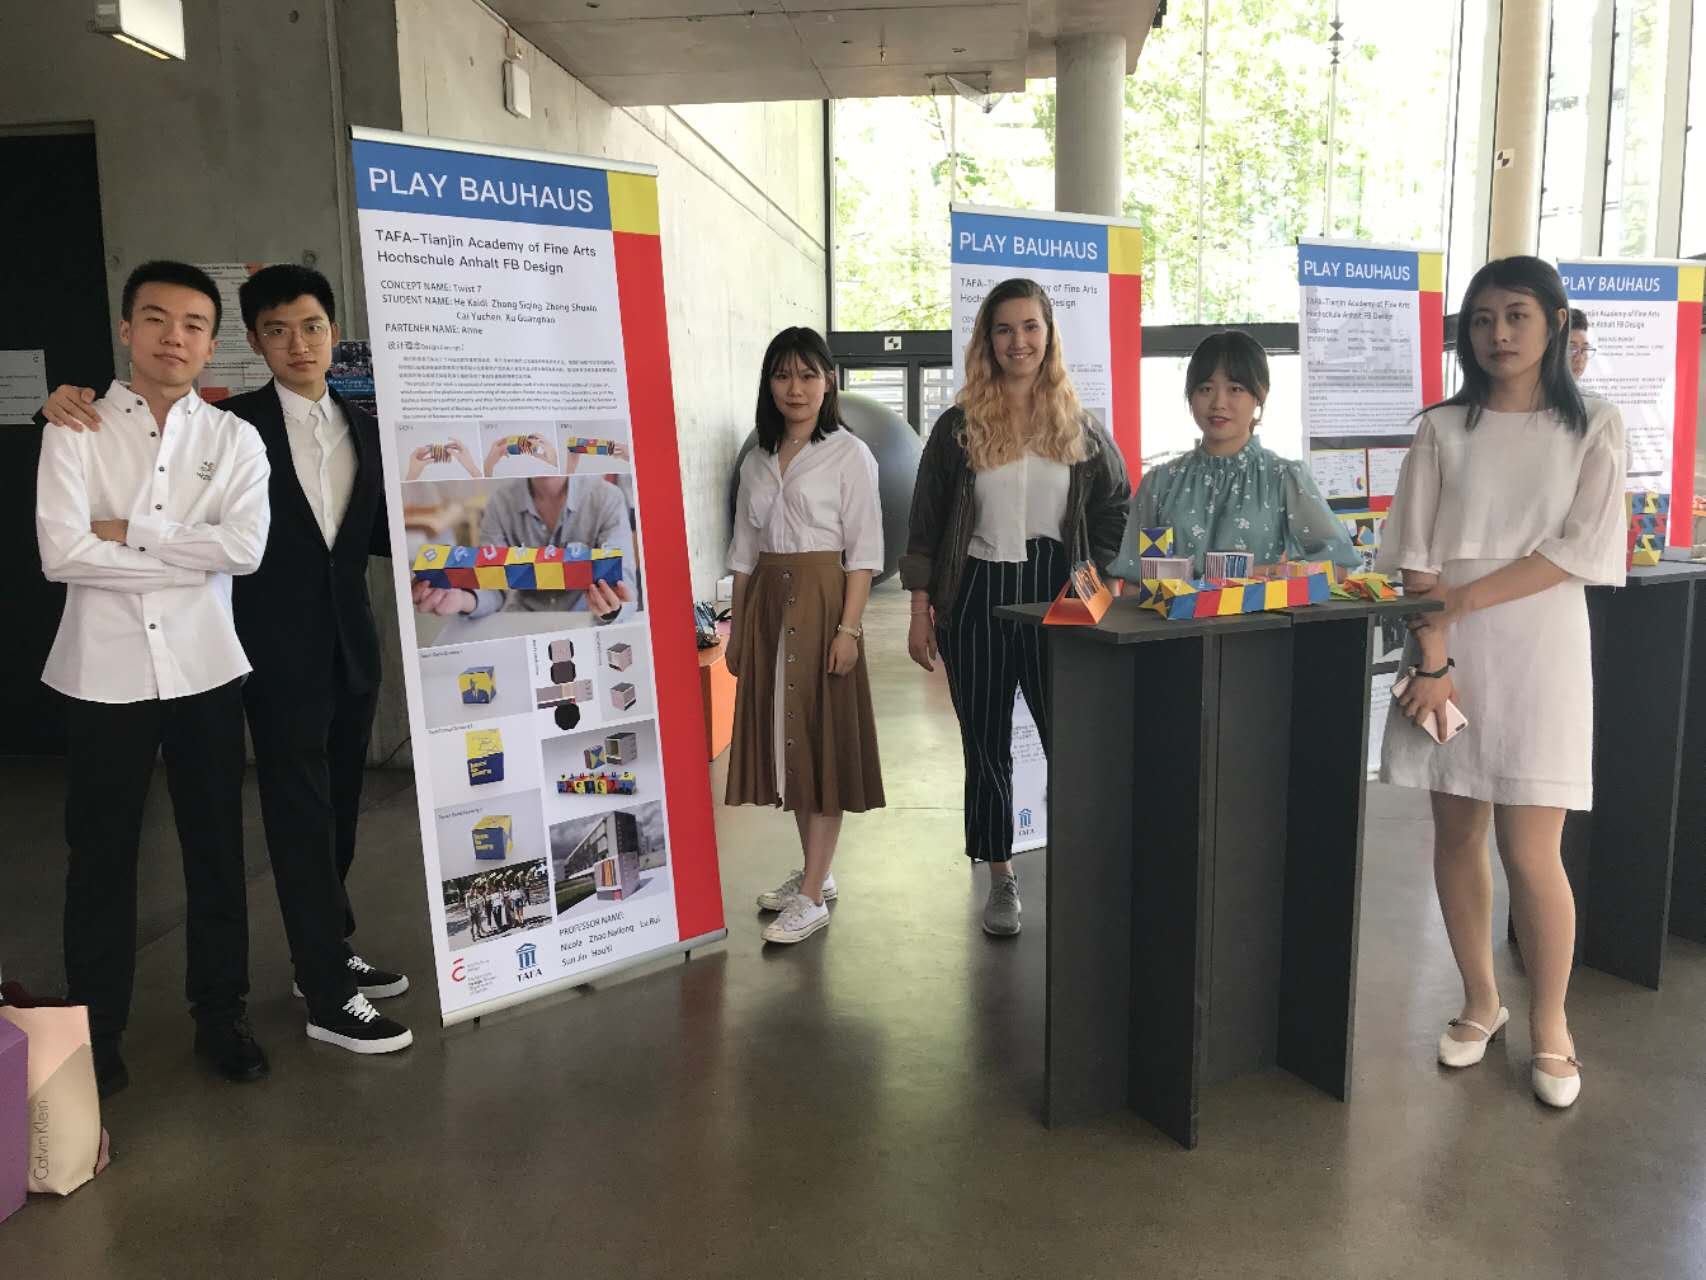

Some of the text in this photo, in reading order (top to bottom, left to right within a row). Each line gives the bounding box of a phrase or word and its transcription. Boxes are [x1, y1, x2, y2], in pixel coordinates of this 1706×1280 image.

[368, 166, 594, 213] PLAY BAUHAUS
[468, 236, 524, 253] Academy
[528, 241, 540, 252] of
[543, 242, 569, 255] Fine
[572, 244, 596, 257] Arts
[959, 231, 1098, 260] PLAY BAUHAUS
[377, 250, 563, 275] Hochschule Anhalt FB Design
[1304, 260, 1410, 281] PLAY BAUHAUS
[380, 280, 422, 290] CONCEPT
[453, 284, 475, 293] Twist
[1064, 284, 1080, 293] Fine
[1082, 286, 1098, 295] Arts
[1562, 276, 1660, 292] PLAY BAUHAUS
[382, 294, 423, 304] STUDENT
[454, 297, 465, 306] He
[559, 918, 600, 937] PROFESSOR
[33, 1100, 49, 1181] Calvin Klein
